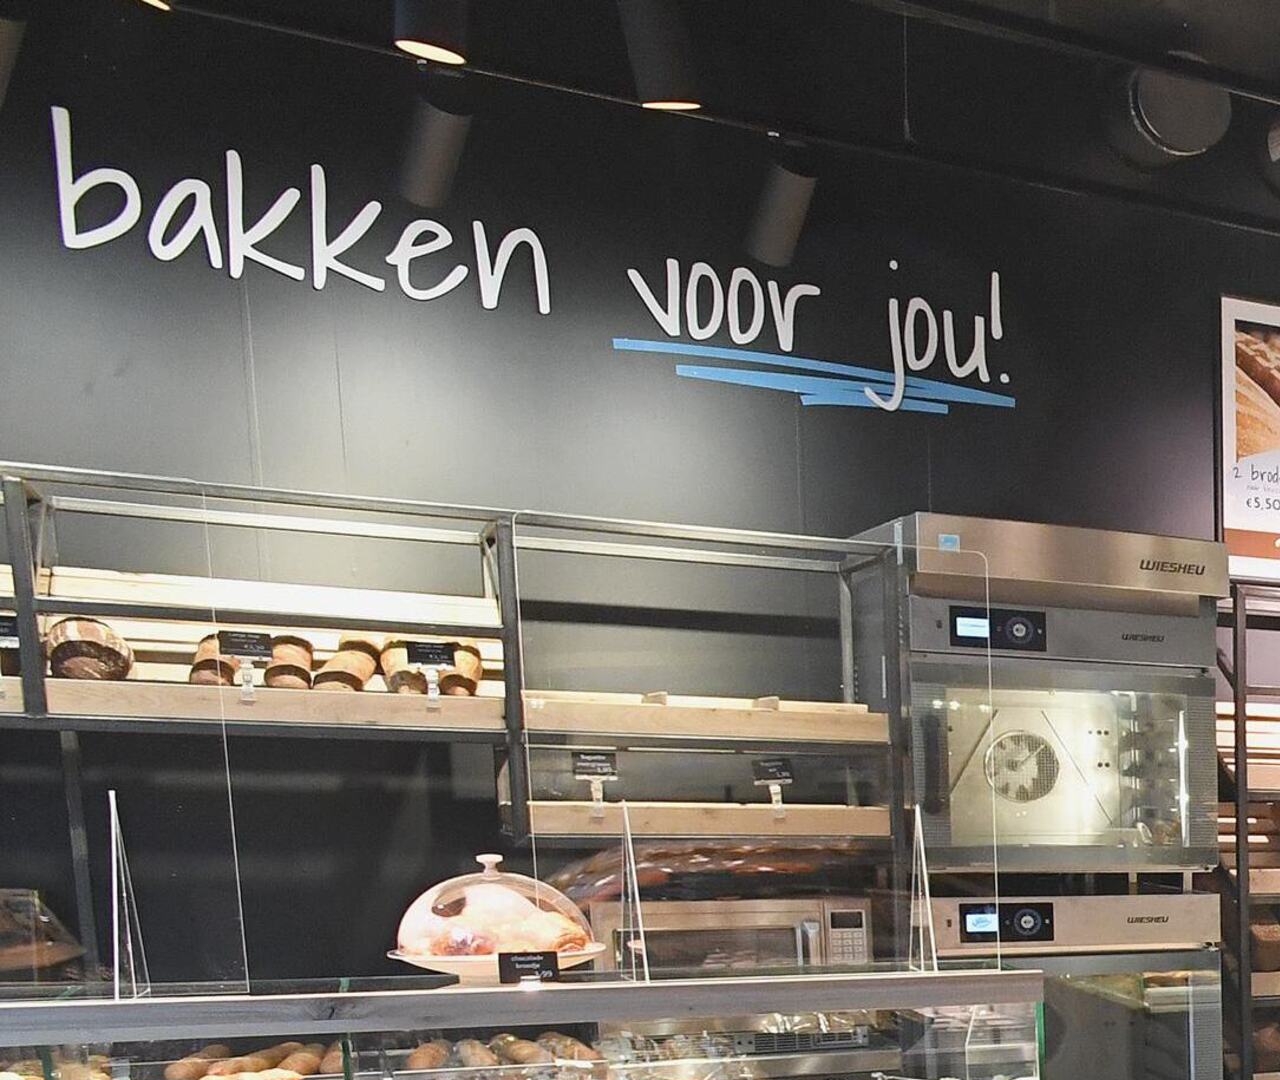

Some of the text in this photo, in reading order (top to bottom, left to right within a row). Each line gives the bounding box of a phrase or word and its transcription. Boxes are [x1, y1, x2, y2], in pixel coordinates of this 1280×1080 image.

[52, 106, 1010, 410] bakken voor jou!
[1232, 466, 1242, 478] 2
[1138, 559, 1206, 577] WIESHEU
[1126, 915, 1170, 925] WIESHEU
